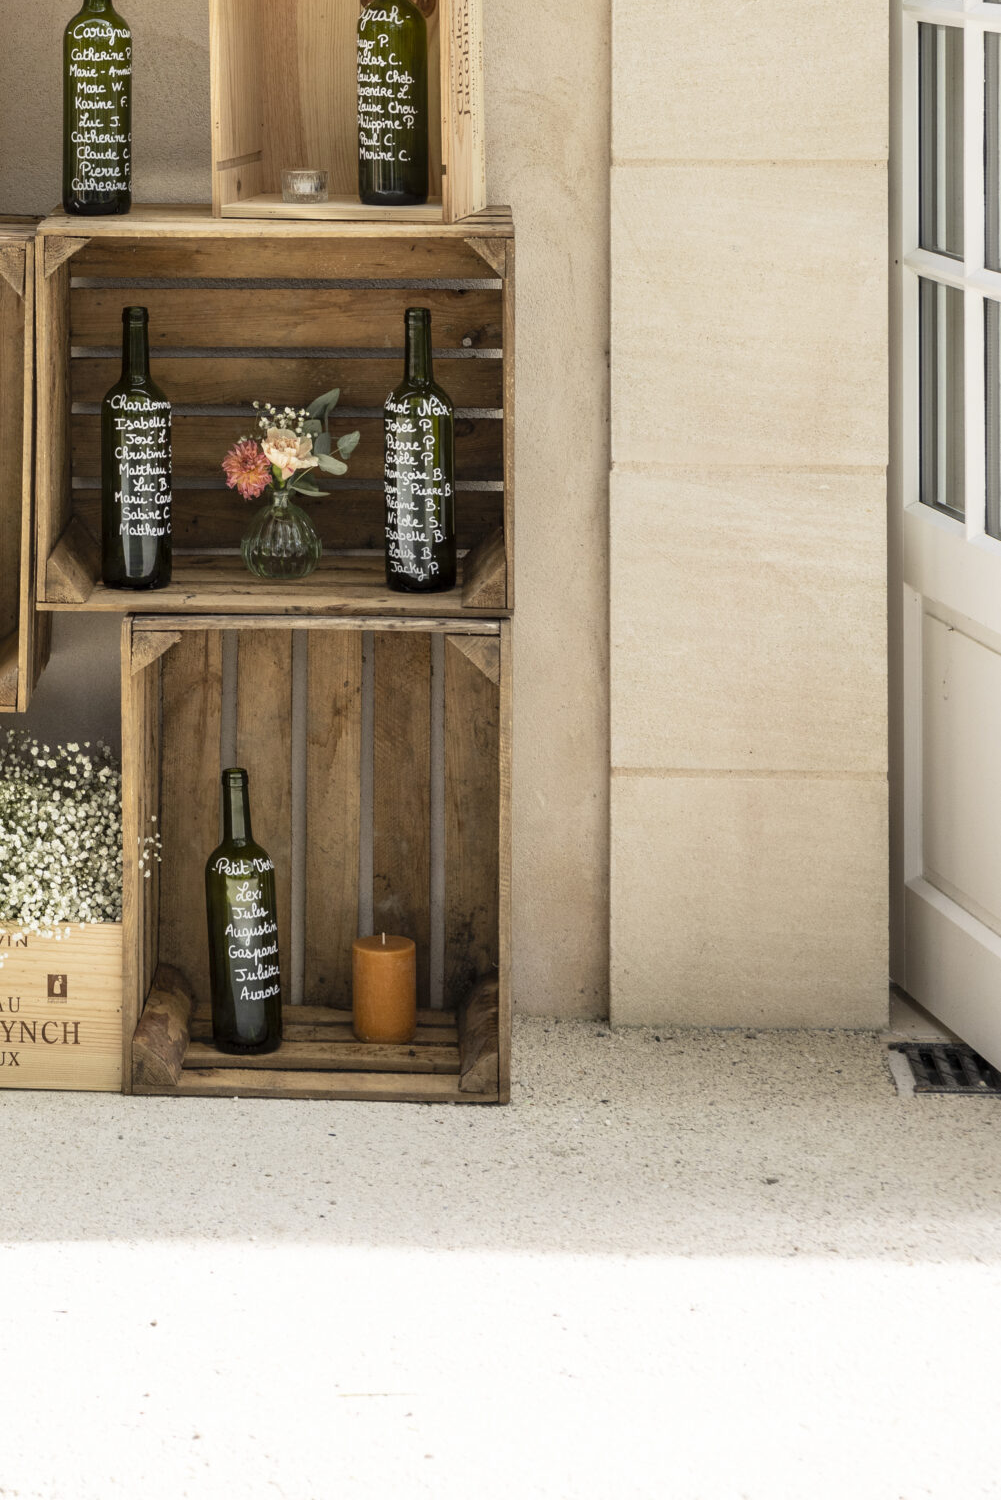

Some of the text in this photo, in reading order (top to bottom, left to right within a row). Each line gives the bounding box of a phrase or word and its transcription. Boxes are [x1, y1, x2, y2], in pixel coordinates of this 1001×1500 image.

[378, 34, 388, 47] P.
[389, 53, 402, 65] C.
[70, 64, 98, 77] Marie
[386, 70, 415, 83] Chab.
[78, 81, 124, 94] Marc W.
[397, 85, 410, 98] L.
[75, 96, 127, 110] Karine F.
[388, 101, 418, 114] Chou.
[79, 113, 120, 127] Luc J.
[403, 115, 414, 129] P.
[359, 132, 395, 145] Paul C.
[77, 146, 119, 159] Claude
[360, 147, 411, 161] Marine C.
[79, 161, 121, 177] Pierre
[114, 417, 166, 430] Isabelle
[385, 419, 432, 433] Josée P.
[126, 429, 168, 444] José L.
[386, 434, 435, 450] Pierre P.
[115, 446, 166, 460] Christine
[386, 451, 433, 466] Gisèle P.
[120, 463, 166, 478] Matthieu
[385, 464, 446, 485] Françoise B.
[133, 477, 169, 491] Luc B.
[115, 491, 147, 504] Marie
[386, 495, 440, 515] Régine B.
[122, 507, 161, 520] Sabine
[388, 512, 442, 528] Nicole S.
[120, 523, 164, 536] Matthew
[385, 527, 447, 543] Isabelle B.
[389, 542, 436, 559] Louis B.
[390, 561, 439, 581] Jacky P.
[236, 882, 263, 902] Lexi
[232, 902, 268, 919] Jules
[225, 920, 277, 946] Augustin
[229, 940, 278, 966] Gaspard
[234, 964, 280, 982] Juliette
[240, 984, 280, 1000] Aurore
